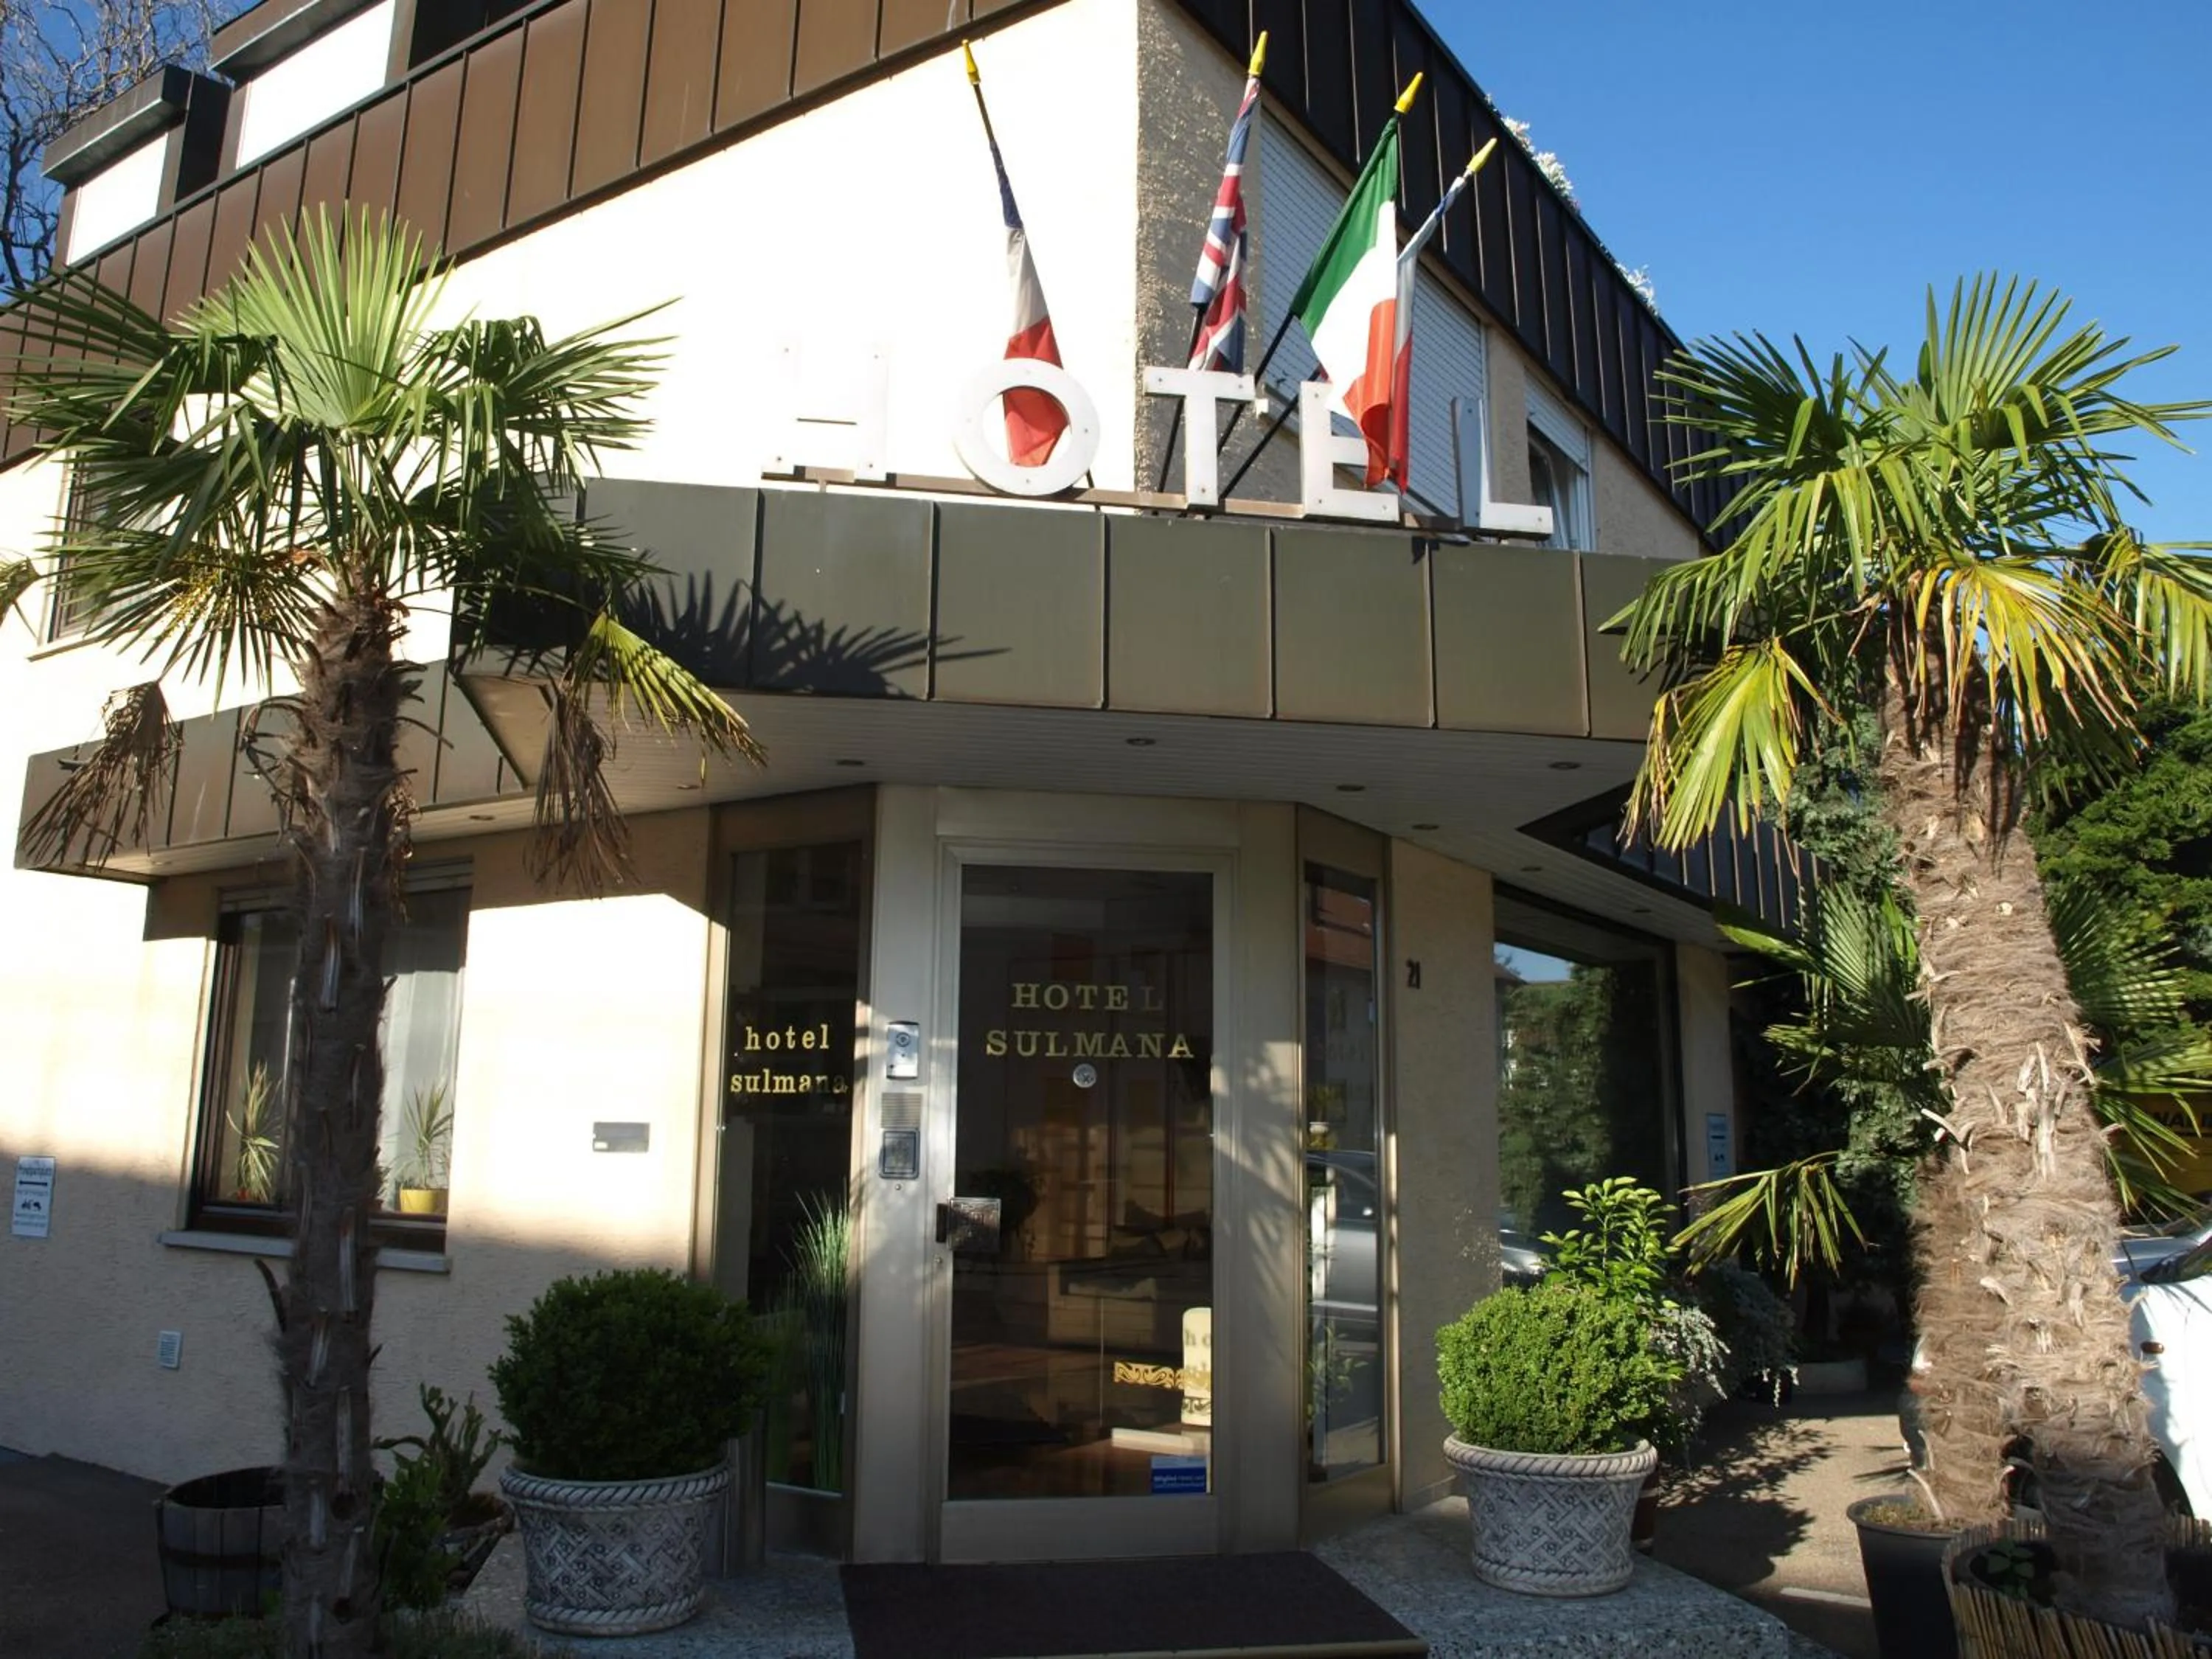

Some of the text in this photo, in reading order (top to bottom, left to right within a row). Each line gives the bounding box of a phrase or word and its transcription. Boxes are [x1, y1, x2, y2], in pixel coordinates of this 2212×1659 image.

[1012, 983, 1164, 1012] HOTEL
[743, 1023, 830, 1051] hotel
[986, 1030, 1194, 1060] SULMANA
[730, 1068, 849, 1094] sulmana
